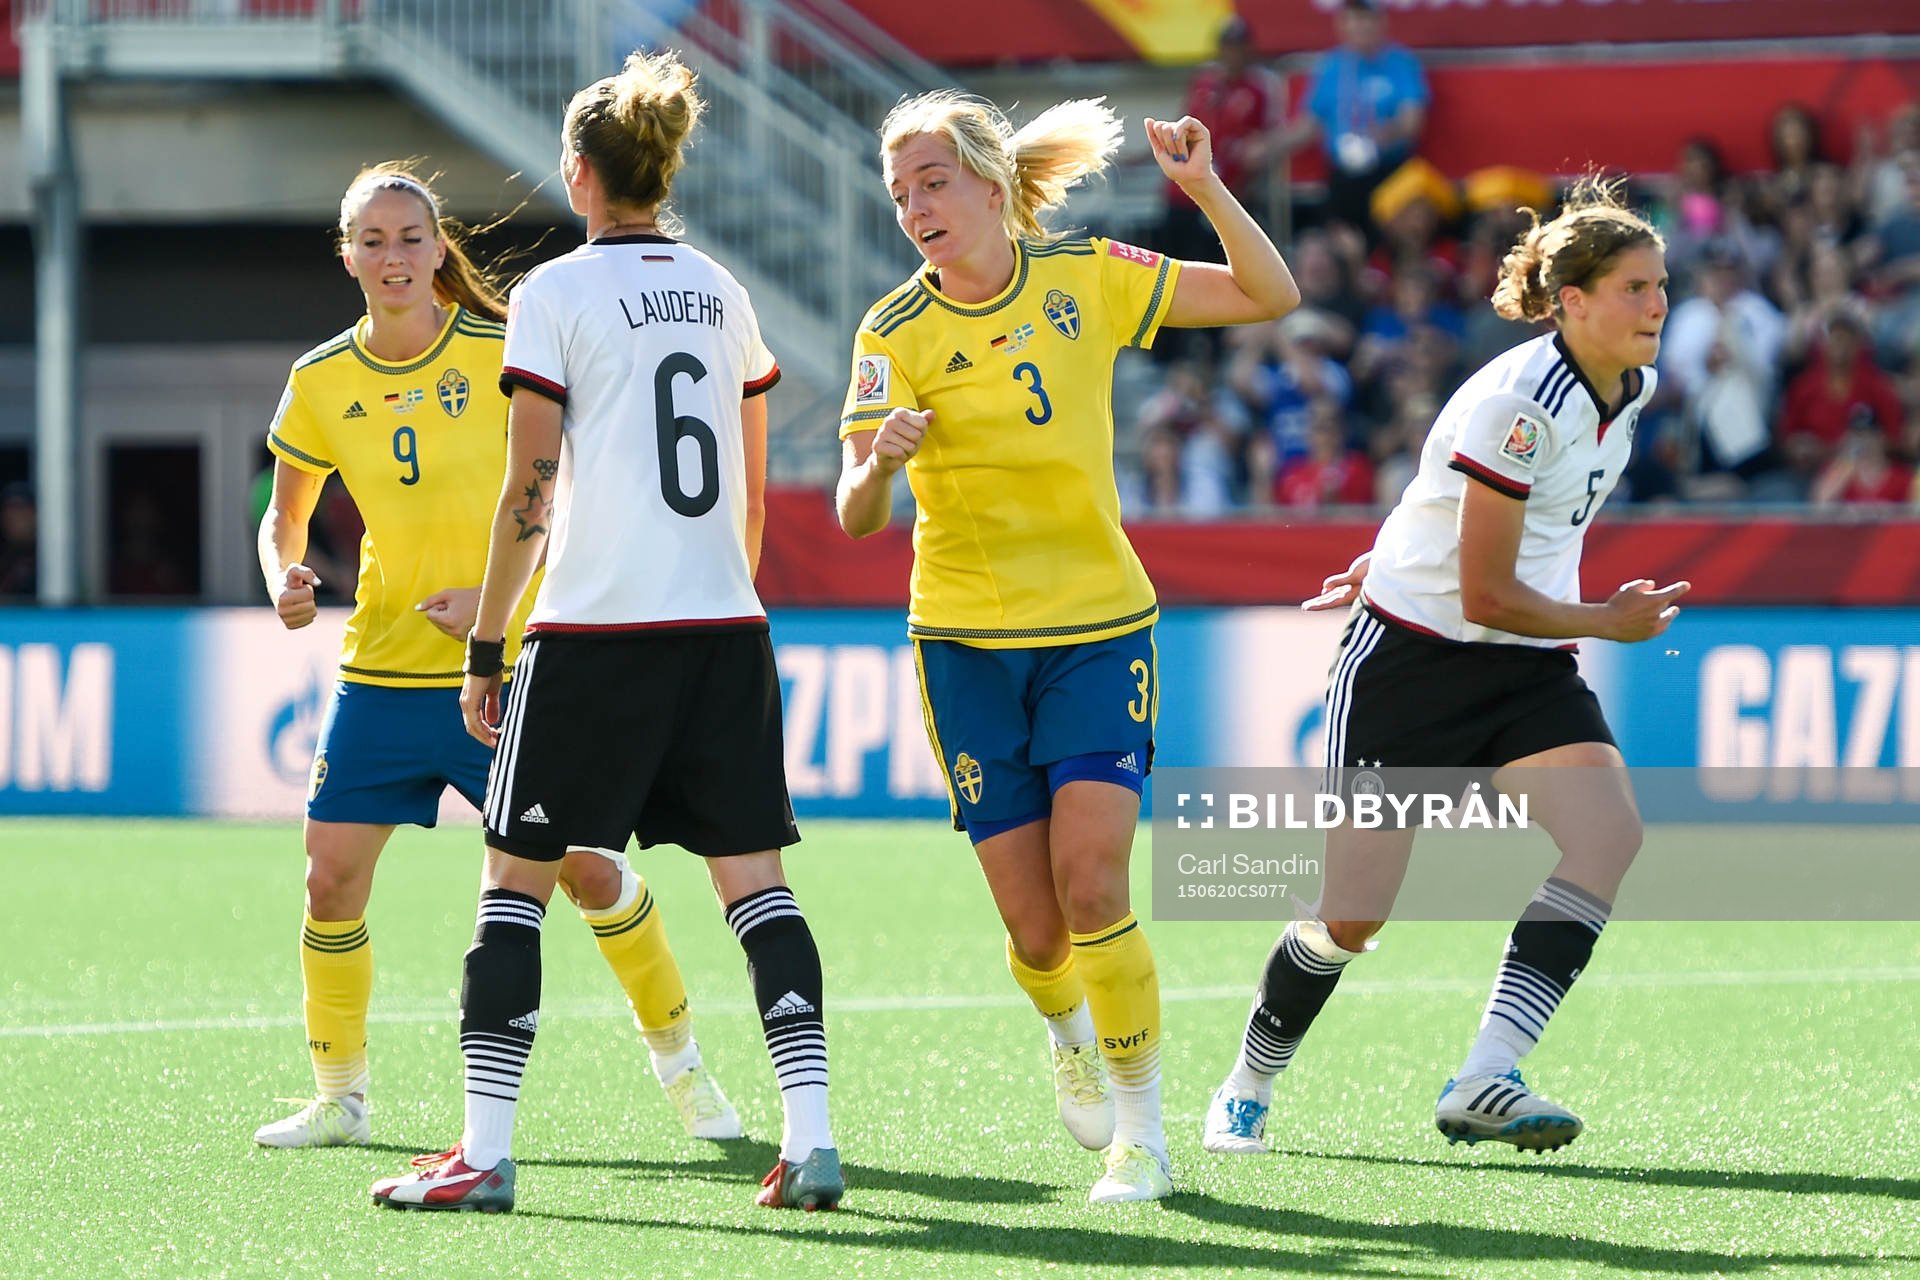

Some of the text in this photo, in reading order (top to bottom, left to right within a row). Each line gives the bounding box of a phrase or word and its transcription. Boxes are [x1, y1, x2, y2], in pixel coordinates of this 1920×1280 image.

[619, 289, 724, 330] LAUDEHR
[944, 361, 973, 374] adidas
[1013, 361, 1053, 426] 3
[654, 352, 720, 517] 6
[393, 426, 420, 486] 9
[1571, 469, 1605, 526] 5
[1128, 659, 1149, 723] 3
[0, 642, 115, 793] M
[1116, 760, 1139, 774] adidas
[520, 815, 549, 824] adidas
[669, 994, 688, 1020] SV
[764, 1003, 815, 1021] adidas
[1103, 1028, 1149, 1049] SVFF
